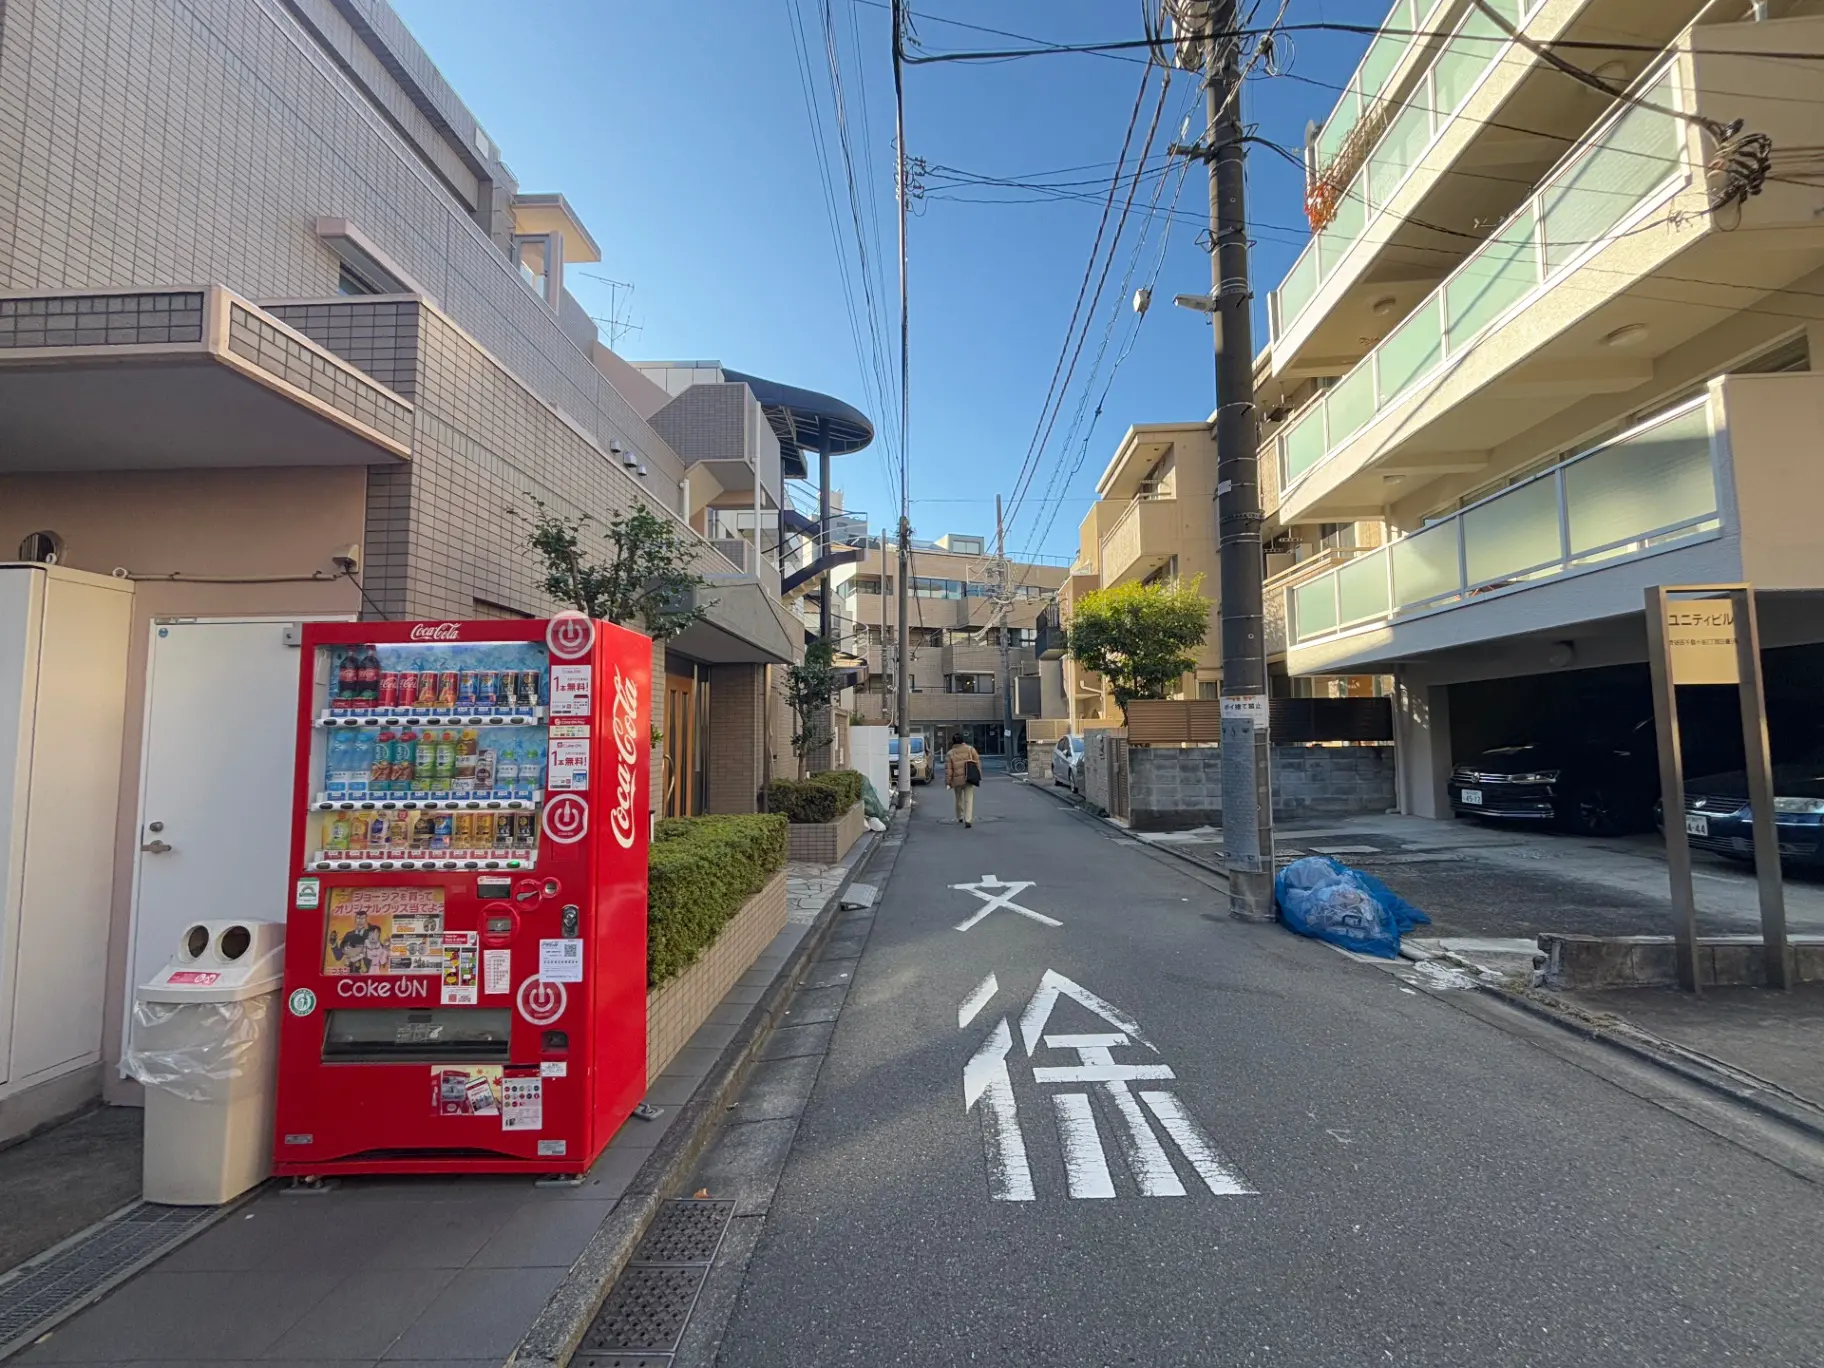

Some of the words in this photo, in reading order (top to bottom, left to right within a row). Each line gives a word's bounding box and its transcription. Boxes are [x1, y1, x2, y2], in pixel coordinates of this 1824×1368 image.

[1668, 613, 1734, 626] ユニティビル
[410, 622, 462, 641] Coca-Cola
[1224, 702, 1262, 711] ポイ捨て禁止
[610, 663, 638, 849] Coca-Cola
[947, 874, 1064, 932] 文
[337, 979, 391, 998] Coke
